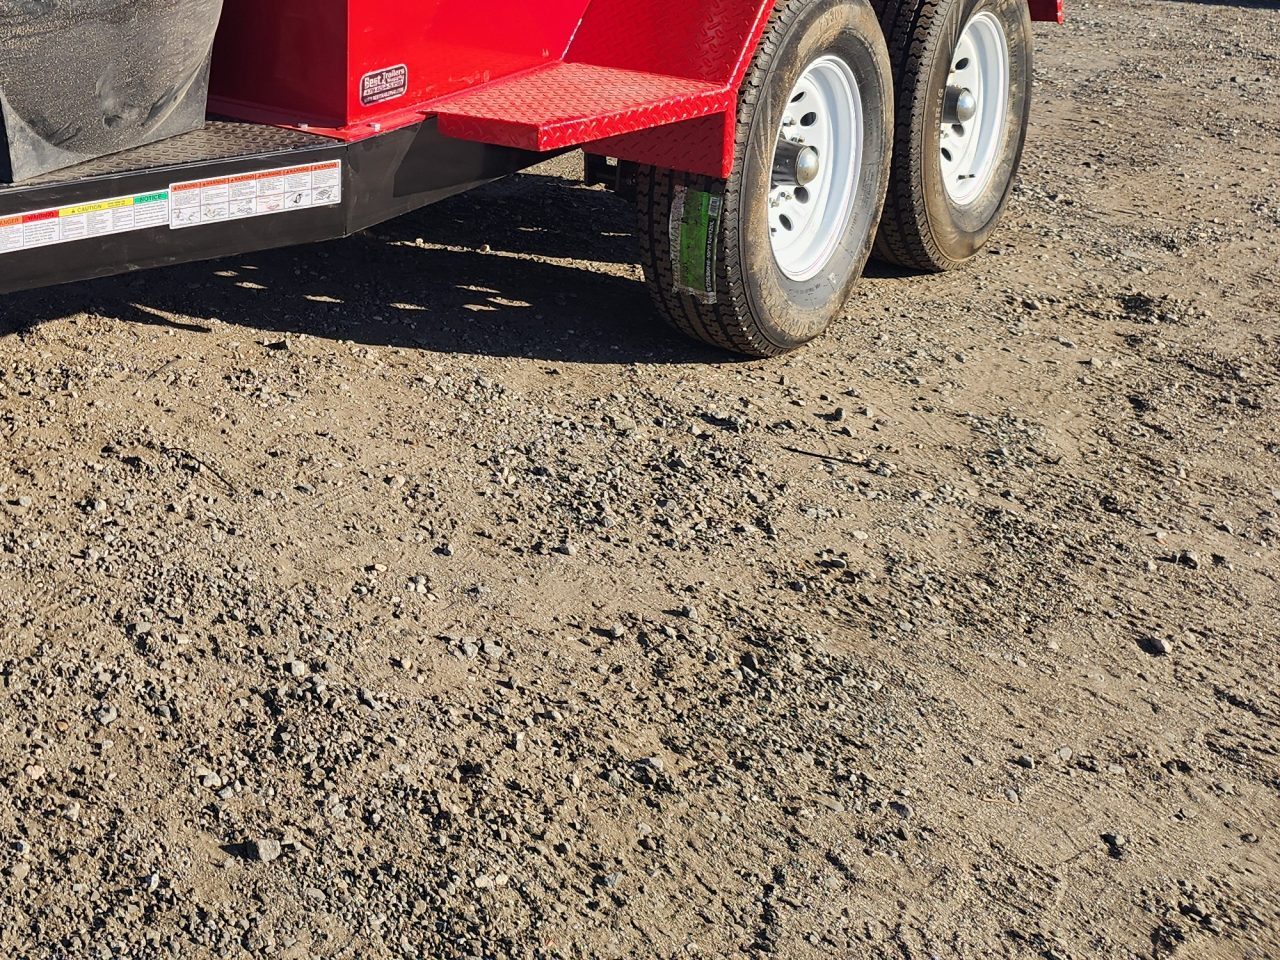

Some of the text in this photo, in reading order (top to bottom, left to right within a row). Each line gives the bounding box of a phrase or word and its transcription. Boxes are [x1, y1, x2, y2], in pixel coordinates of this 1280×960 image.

[364, 75, 382, 89] Best
[139, 193, 162, 202] NOTICE
[77, 204, 102, 213] CAUTION
